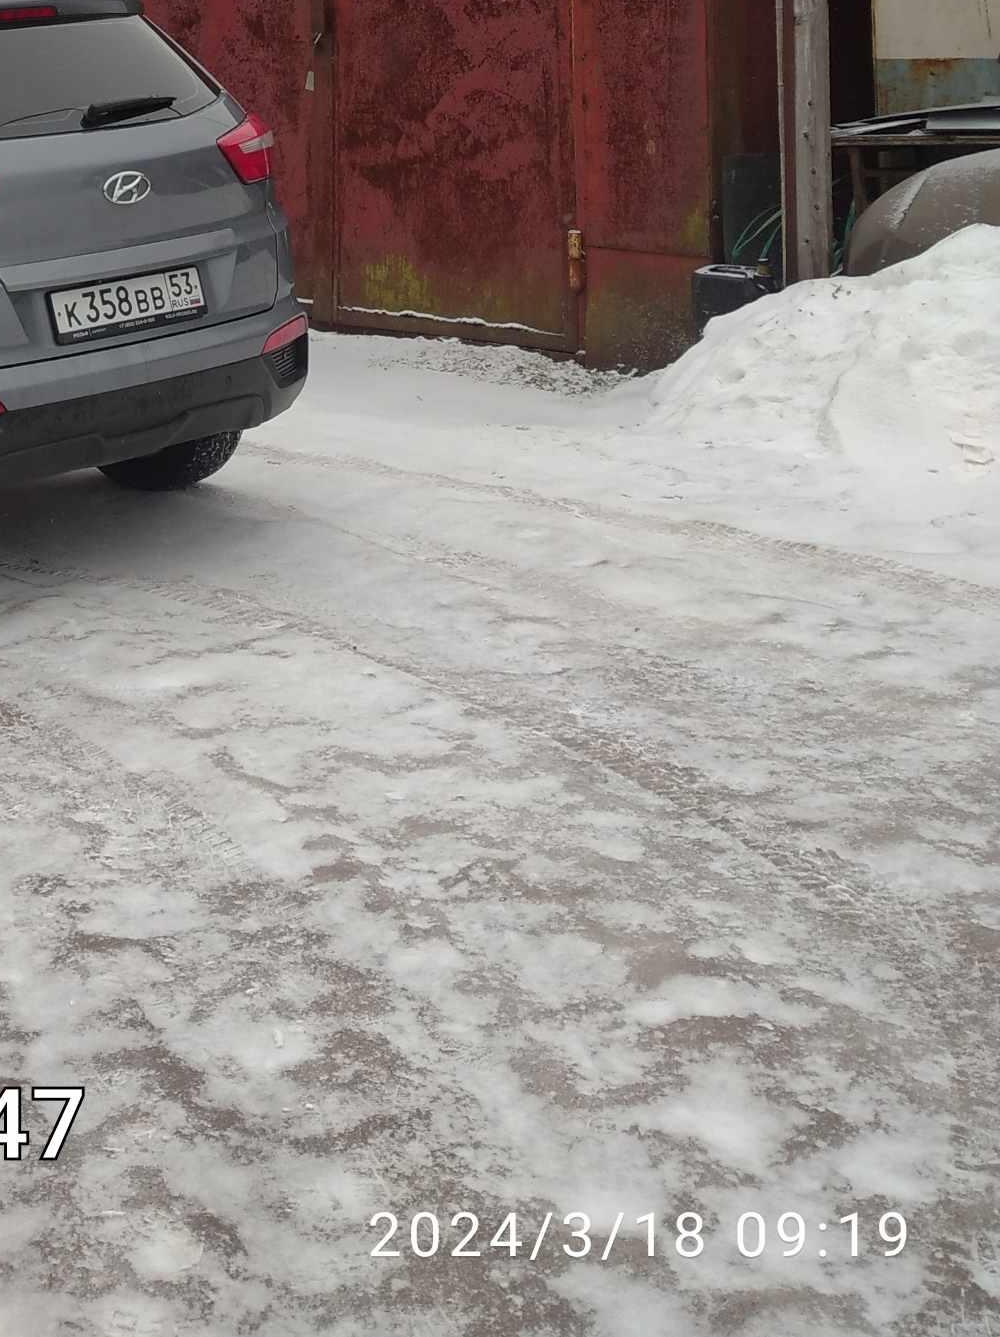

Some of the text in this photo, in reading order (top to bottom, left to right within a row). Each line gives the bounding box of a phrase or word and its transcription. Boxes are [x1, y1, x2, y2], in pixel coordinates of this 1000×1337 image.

[64, 271, 193, 328] К358ВВ 53
[171, 297, 190, 308] RUS
